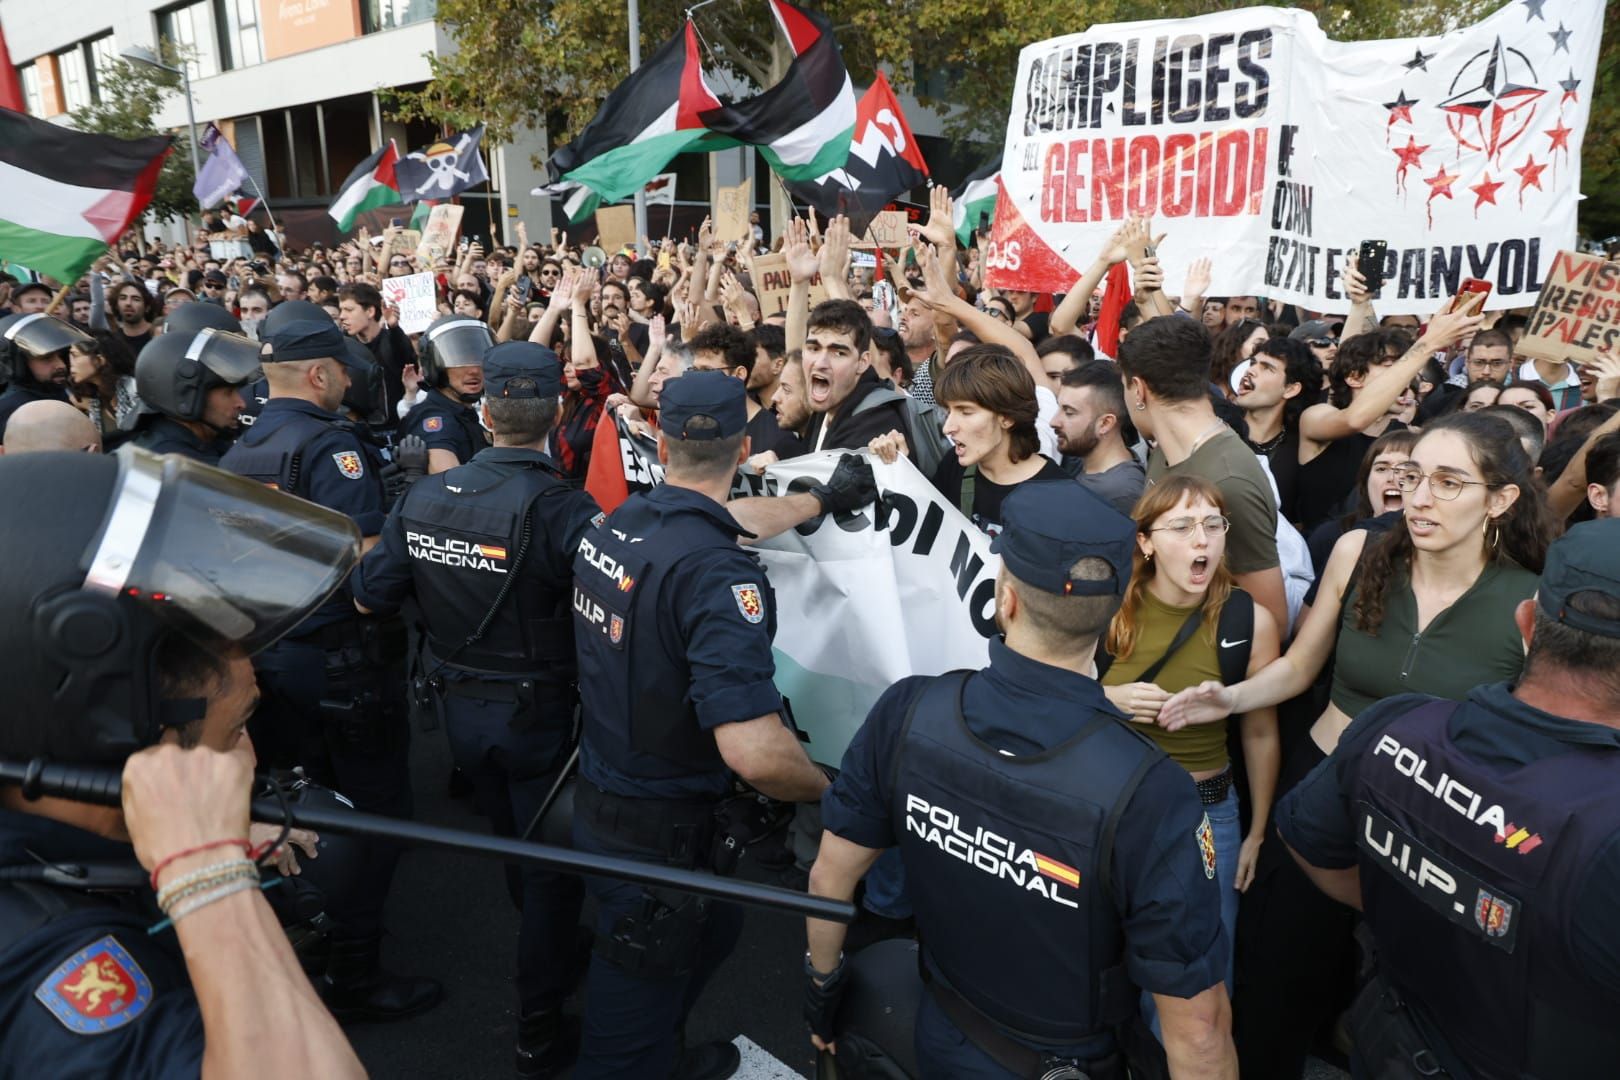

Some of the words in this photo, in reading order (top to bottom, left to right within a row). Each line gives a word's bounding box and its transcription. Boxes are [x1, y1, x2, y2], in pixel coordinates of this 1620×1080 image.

[1040, 127, 1269, 224] GENOCIDI
[1325, 236, 1543, 300] EPANYOL
[1563, 253, 1620, 293] VIS
[1530, 310, 1620, 353] PALES
[406, 531, 484, 557] POLICIA
[407, 545, 508, 574] NACIONAL
[577, 537, 626, 585] POLICIA
[1373, 734, 1506, 839] POLICIA
[906, 793, 1041, 873] POLICIA
[906, 814, 1079, 909] NACIONAL
